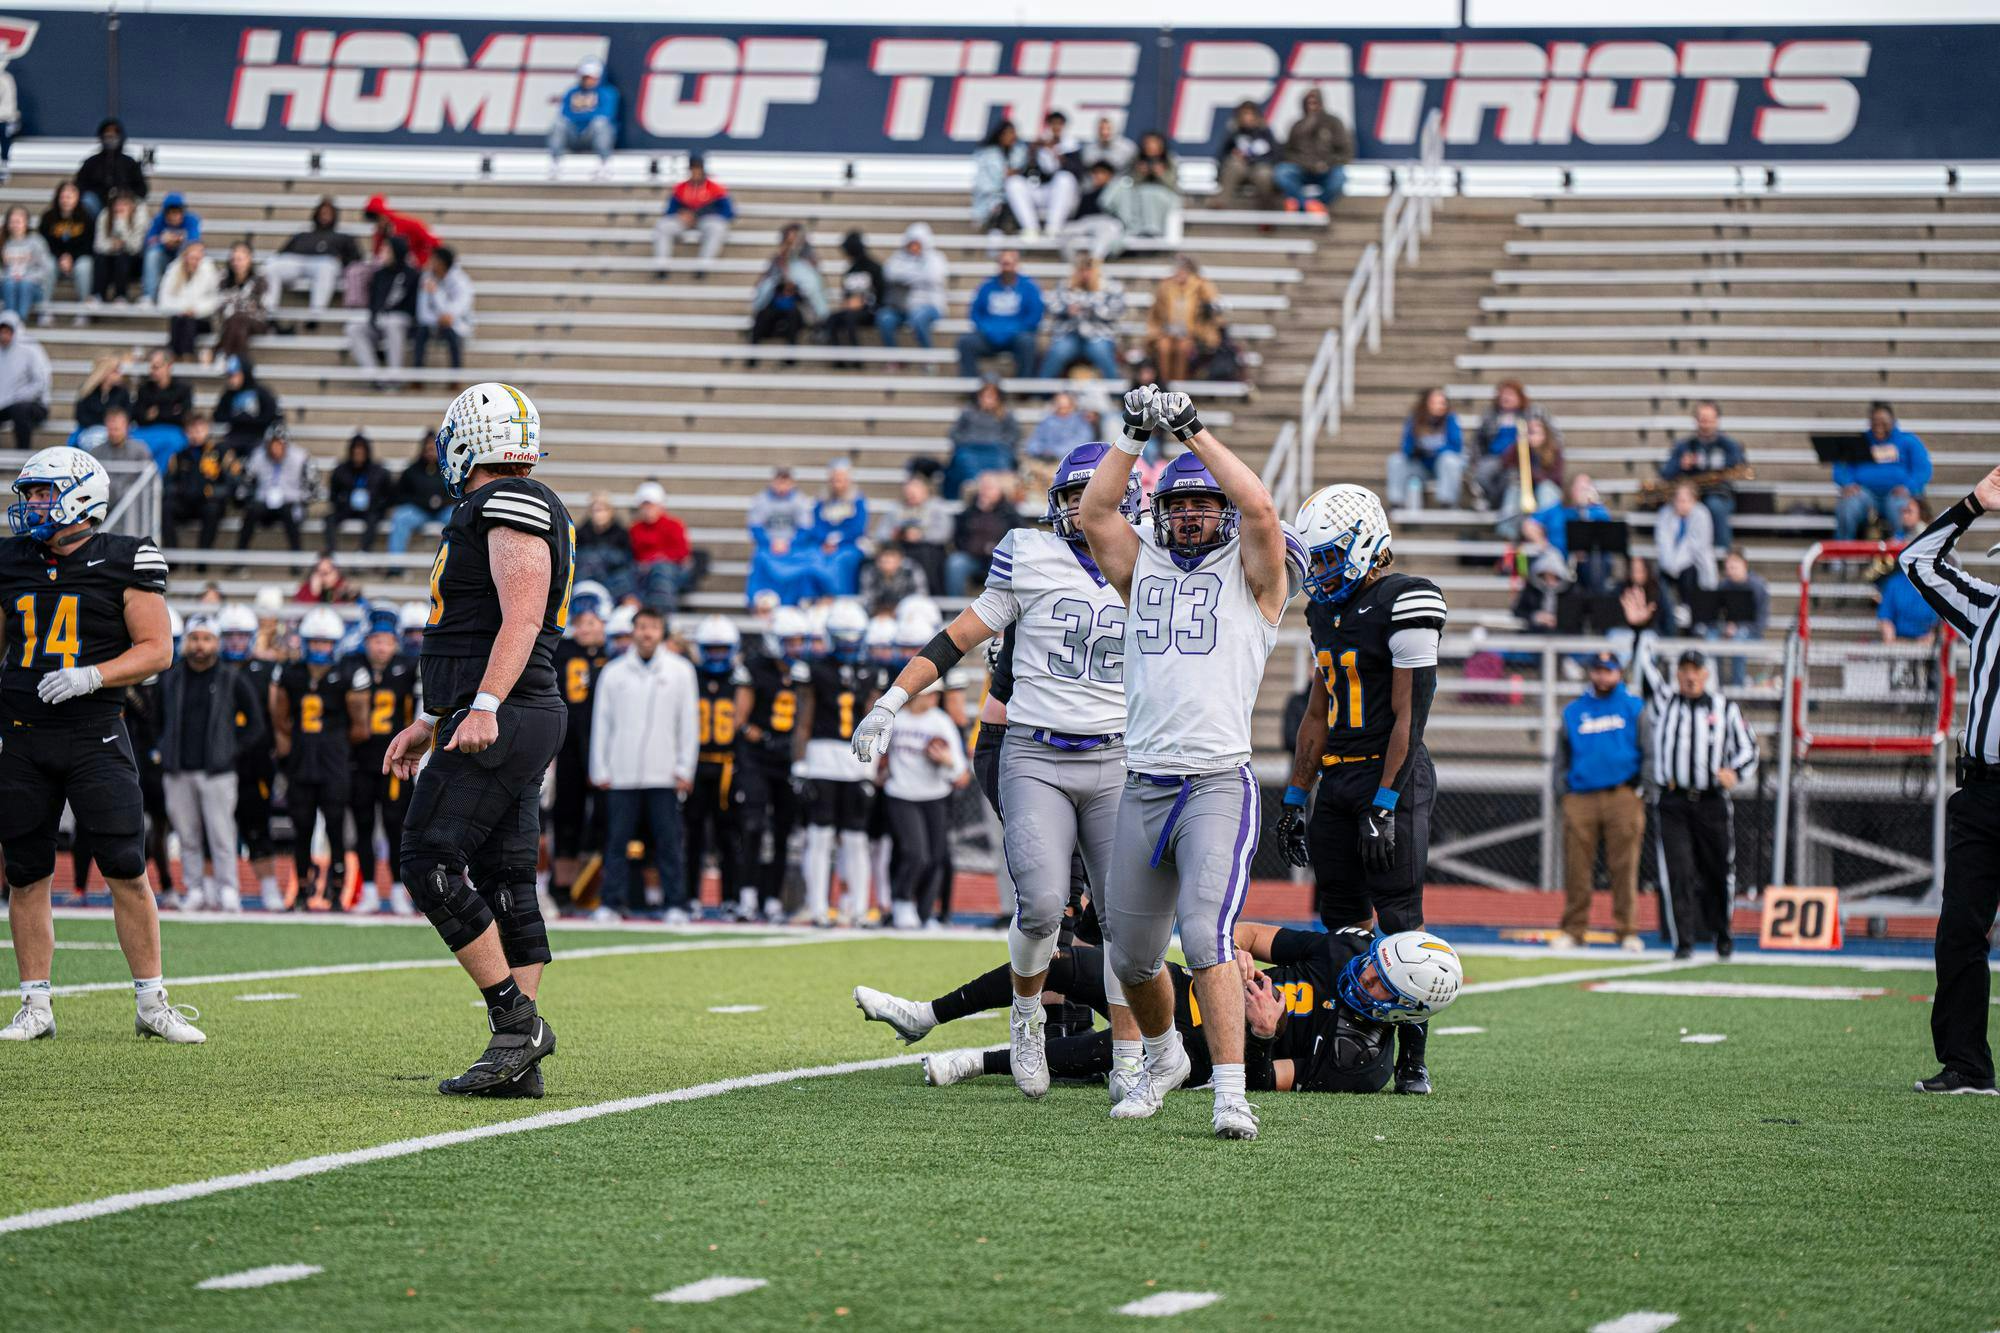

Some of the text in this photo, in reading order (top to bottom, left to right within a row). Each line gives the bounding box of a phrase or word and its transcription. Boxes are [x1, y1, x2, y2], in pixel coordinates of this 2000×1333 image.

[226, 28, 1872, 145] HOME OF THE PATRIOTS
[503, 451, 539, 463] Riddell
[15, 592, 82, 671] 14
[1047, 598, 1126, 684] 32
[1136, 573, 1223, 655] 93
[370, 688, 397, 735] 2
[1771, 899, 1825, 938] 20
